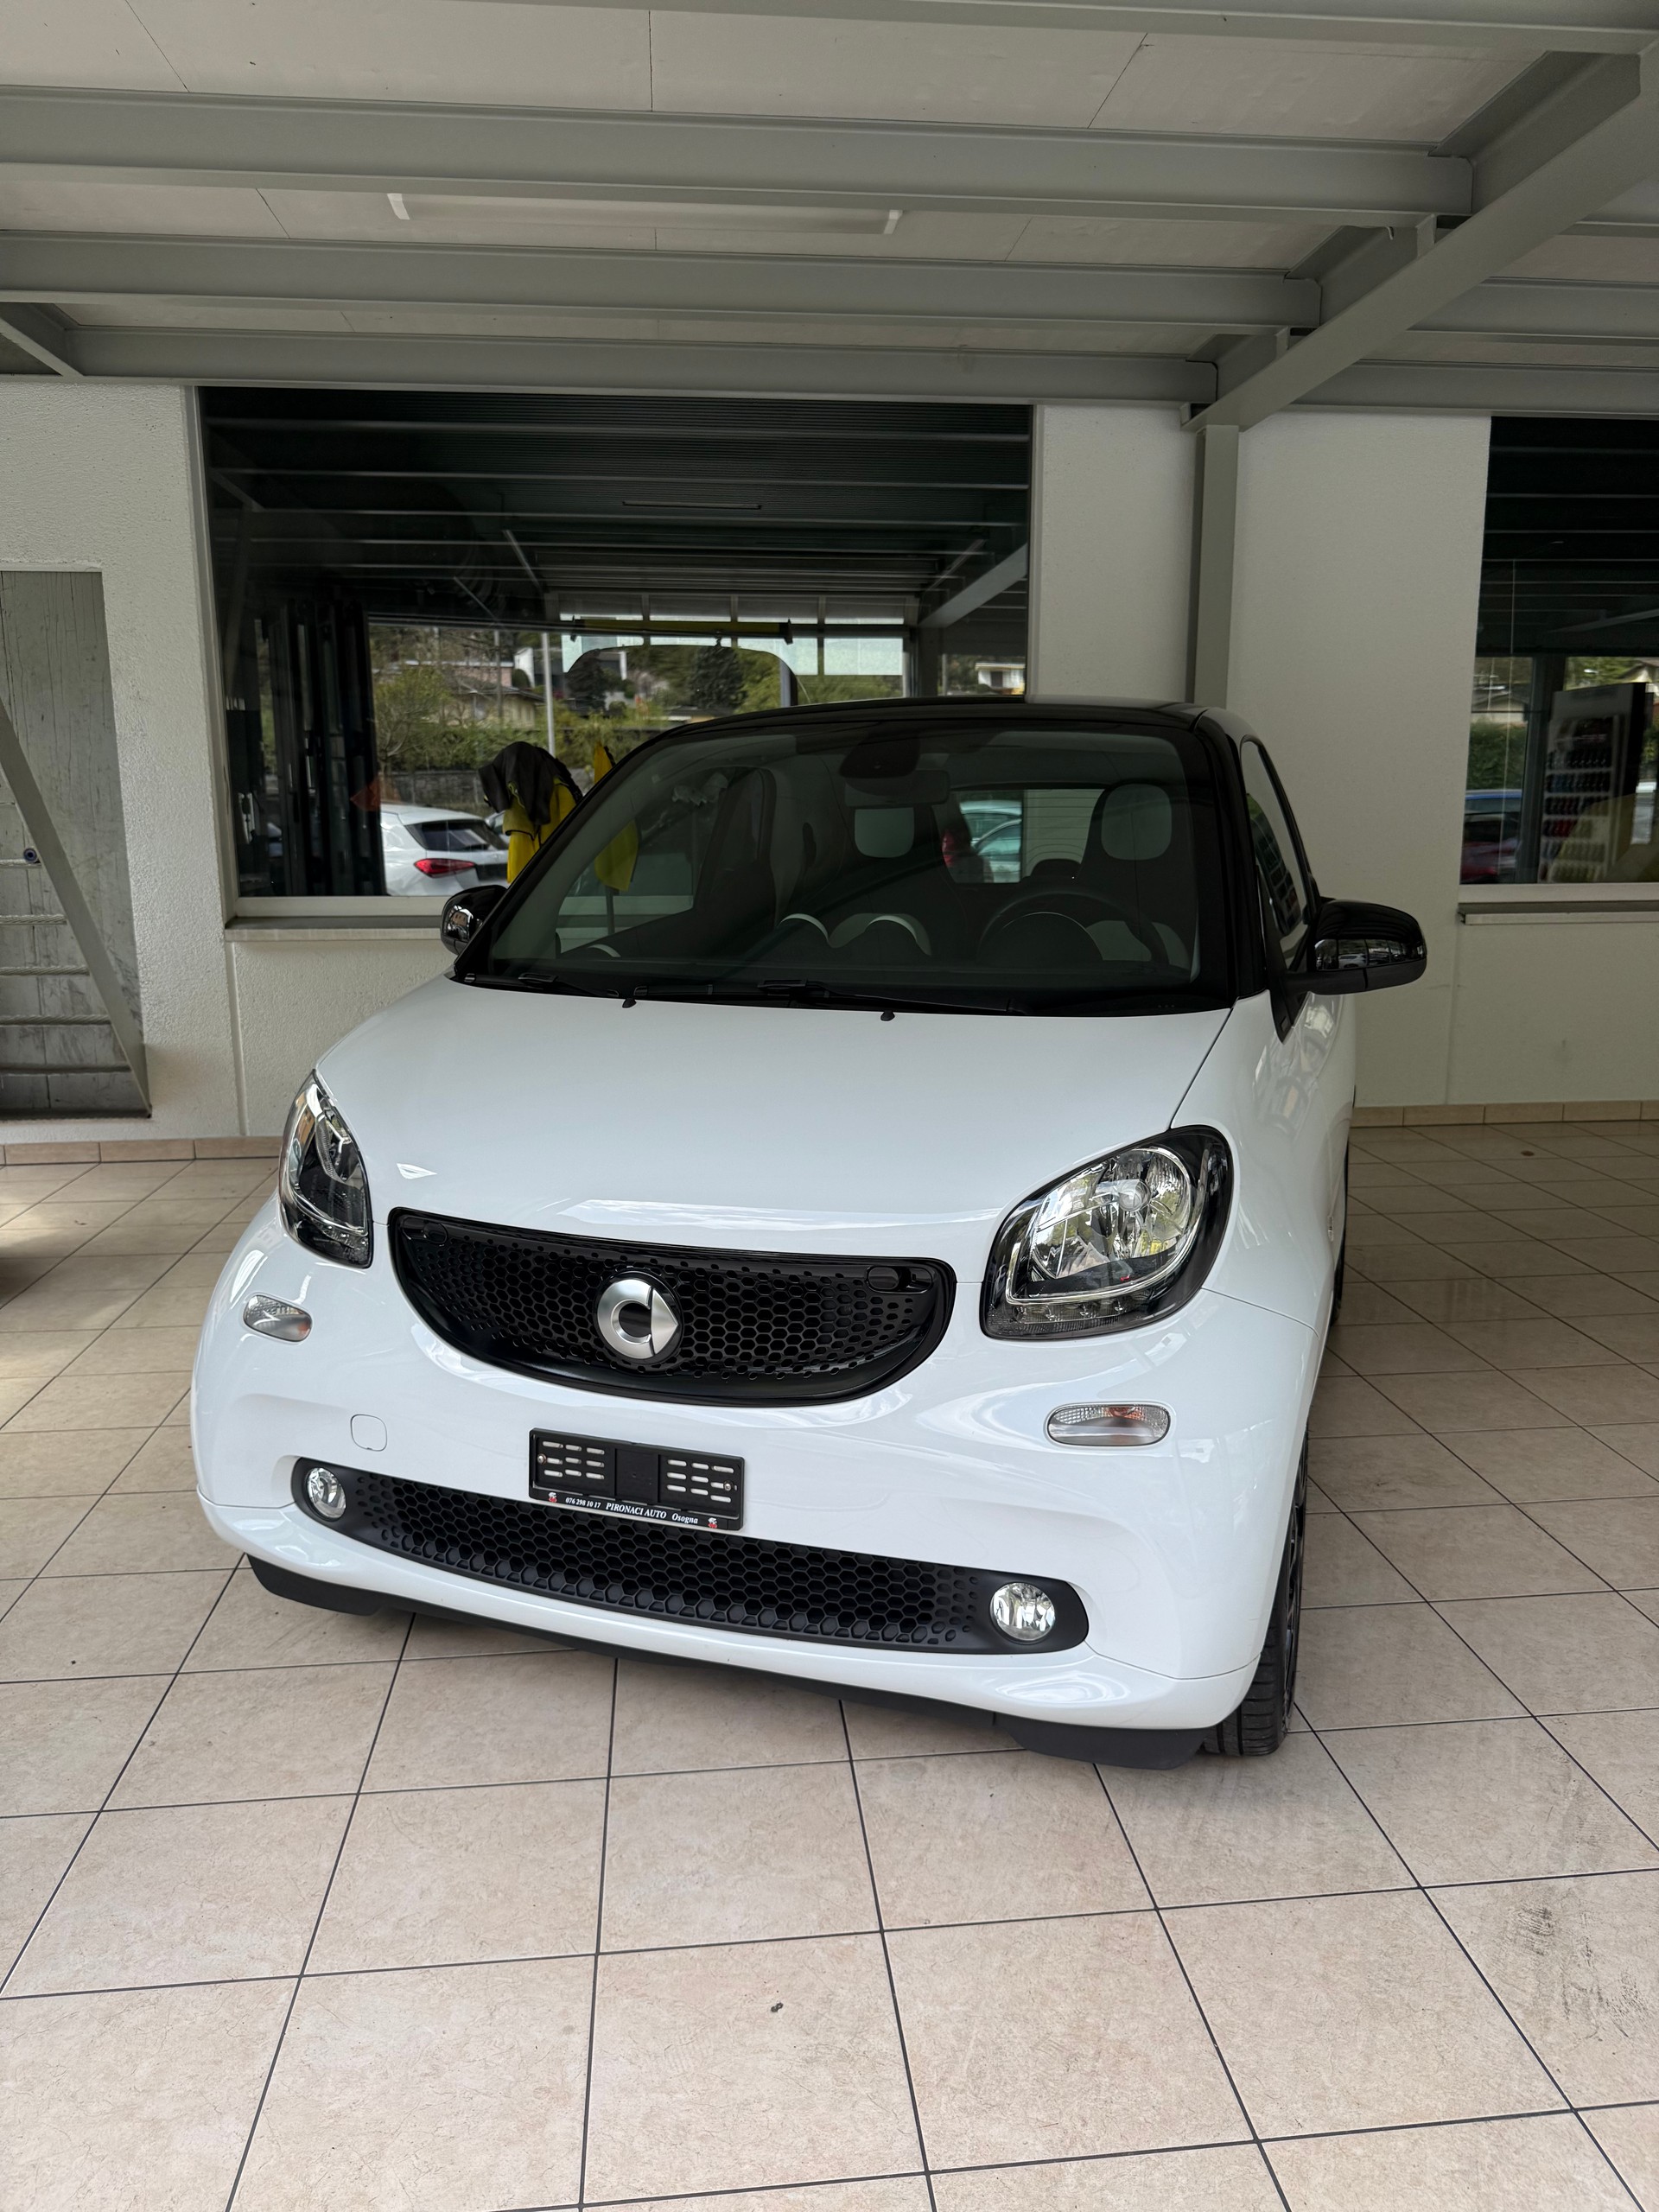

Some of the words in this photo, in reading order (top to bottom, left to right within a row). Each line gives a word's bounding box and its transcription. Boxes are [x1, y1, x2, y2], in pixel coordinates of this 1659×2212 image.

[606, 1503, 643, 1516] PIRONACI
[644, 1509, 667, 1519] AUTO
[671, 1513, 698, 1524] Osogna
